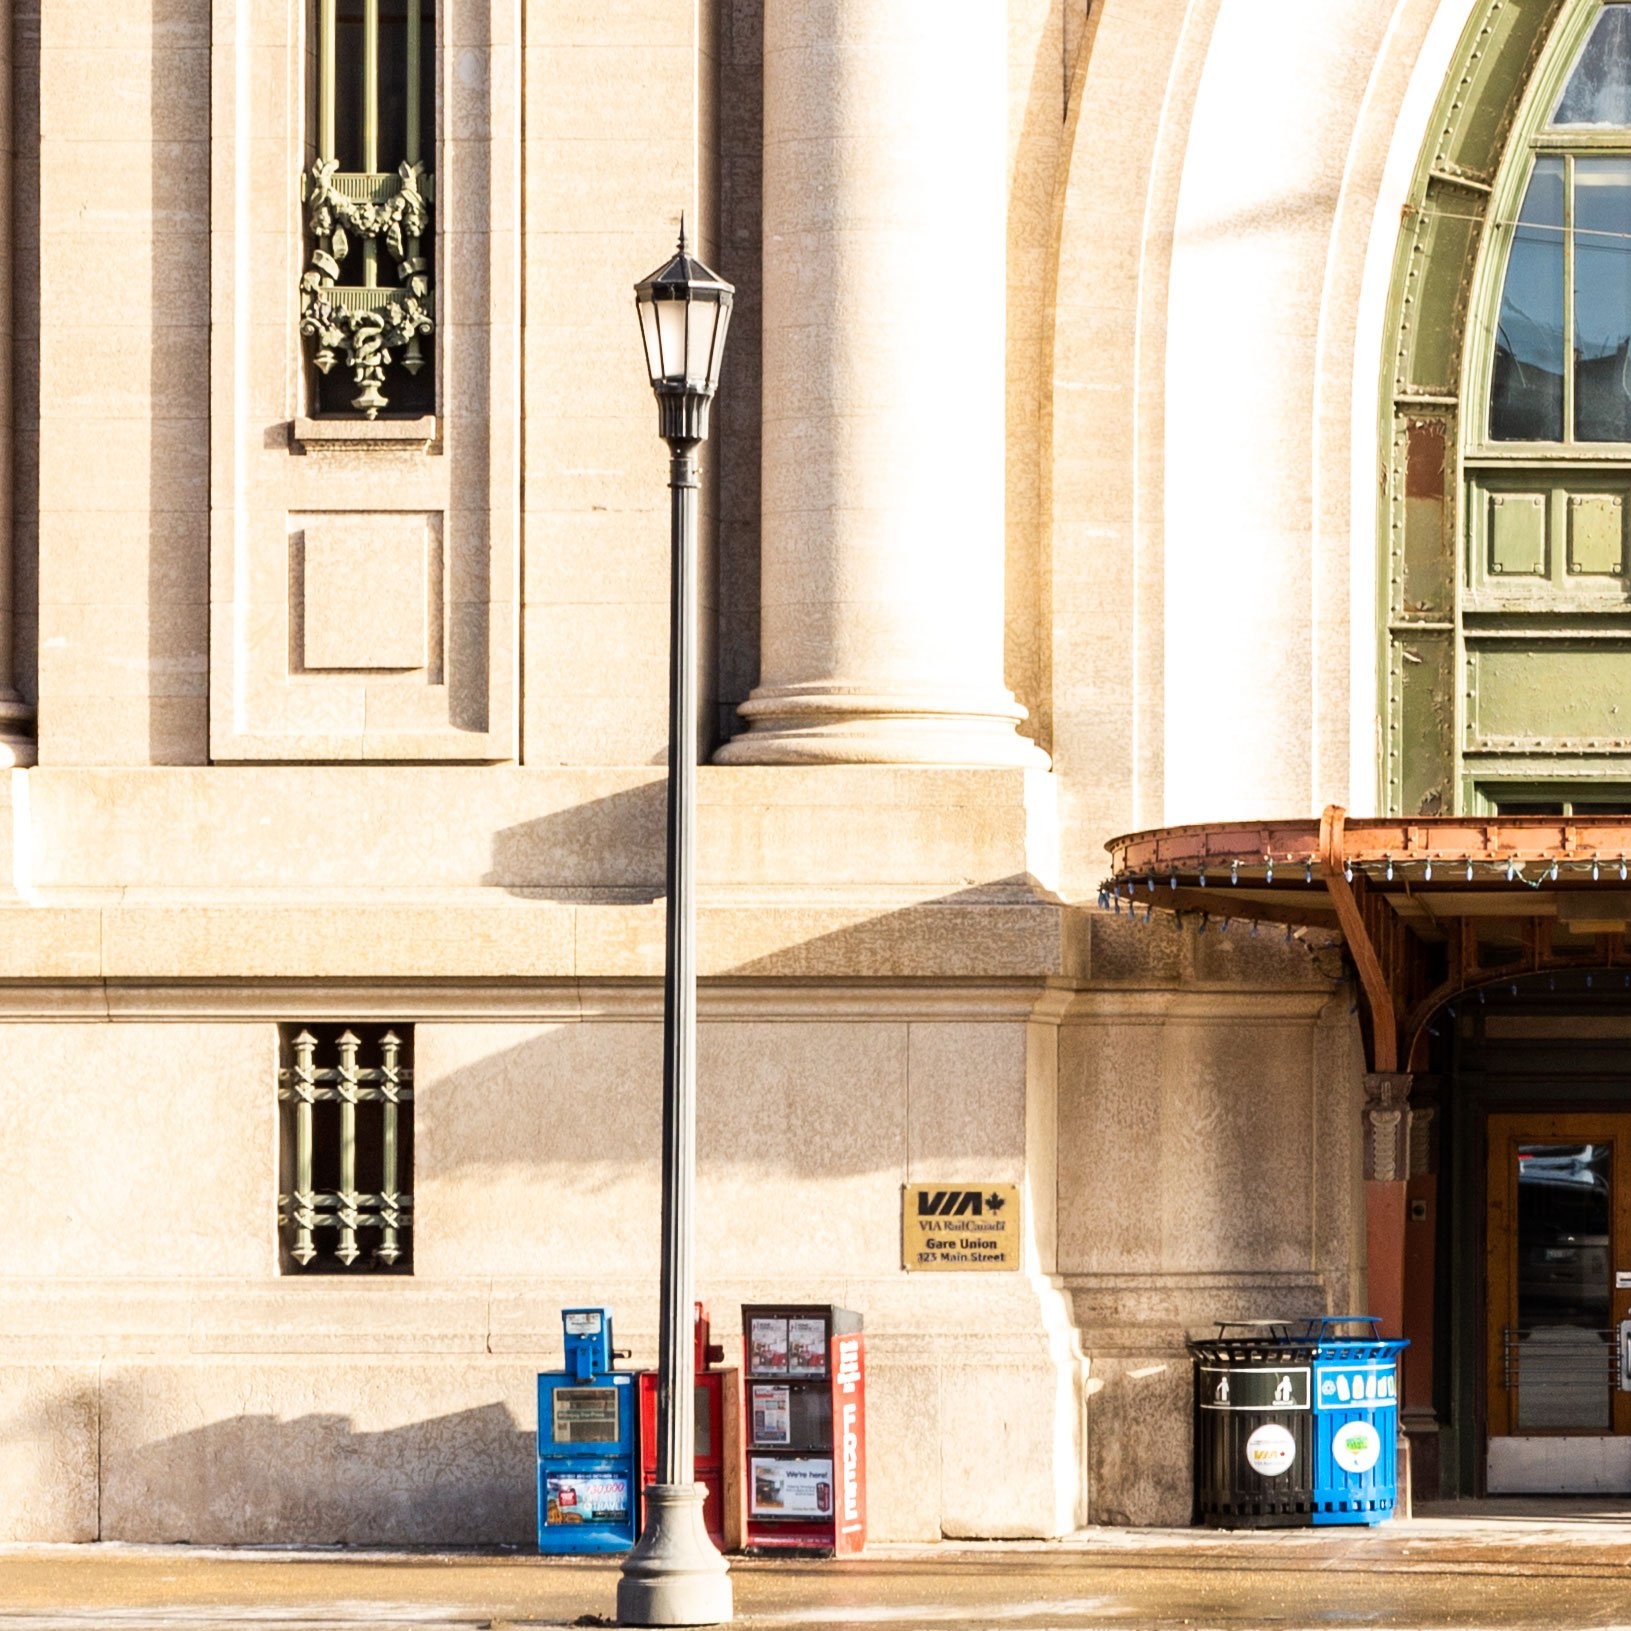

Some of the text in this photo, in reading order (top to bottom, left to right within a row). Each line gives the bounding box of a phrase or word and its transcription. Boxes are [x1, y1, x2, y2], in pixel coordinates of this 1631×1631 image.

[917, 1191, 983, 1216] VIA
[919, 1221, 942, 1231] VIA
[944, 1221, 965, 1231] Rail
[926, 1238, 997, 1249] Gare Union
[918, 1252, 1005, 1263] 123 Main Street
